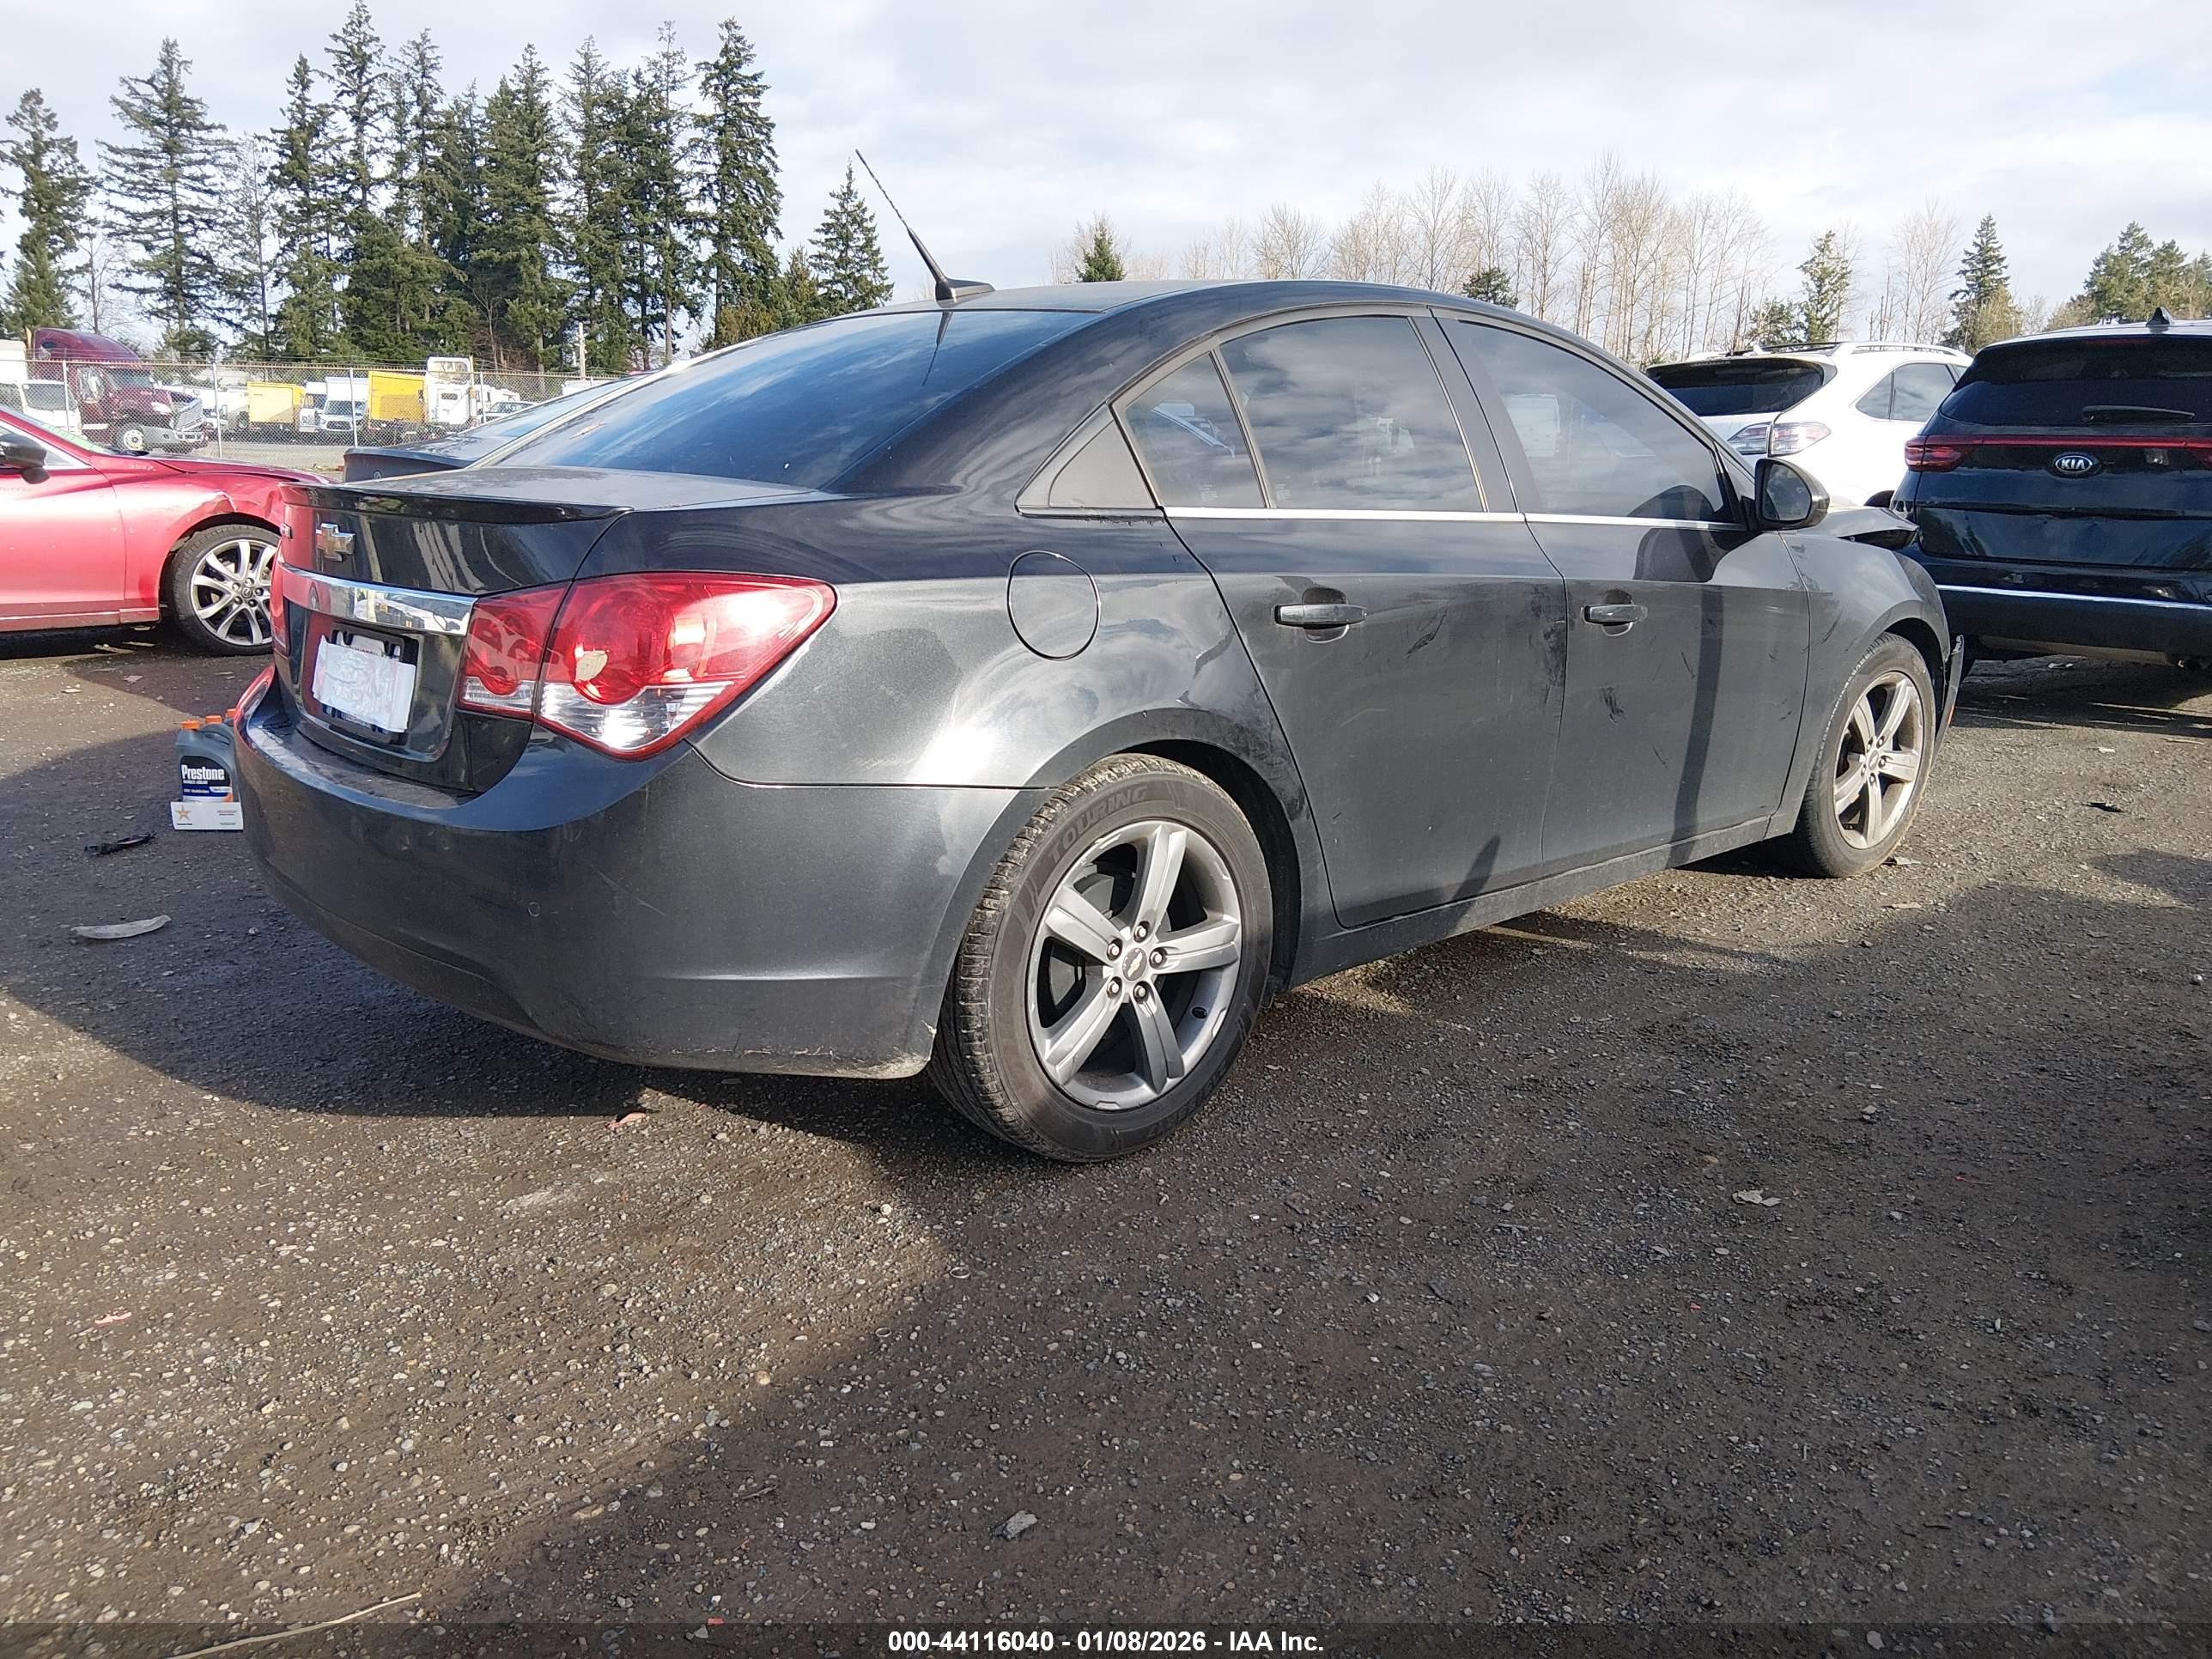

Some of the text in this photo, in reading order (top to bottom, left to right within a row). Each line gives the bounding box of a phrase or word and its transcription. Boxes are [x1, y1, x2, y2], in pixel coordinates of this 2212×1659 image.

[2061, 459, 2085, 470] KIA
[181, 764, 225, 781] Prestone
[1048, 785, 1148, 864] TOURING
